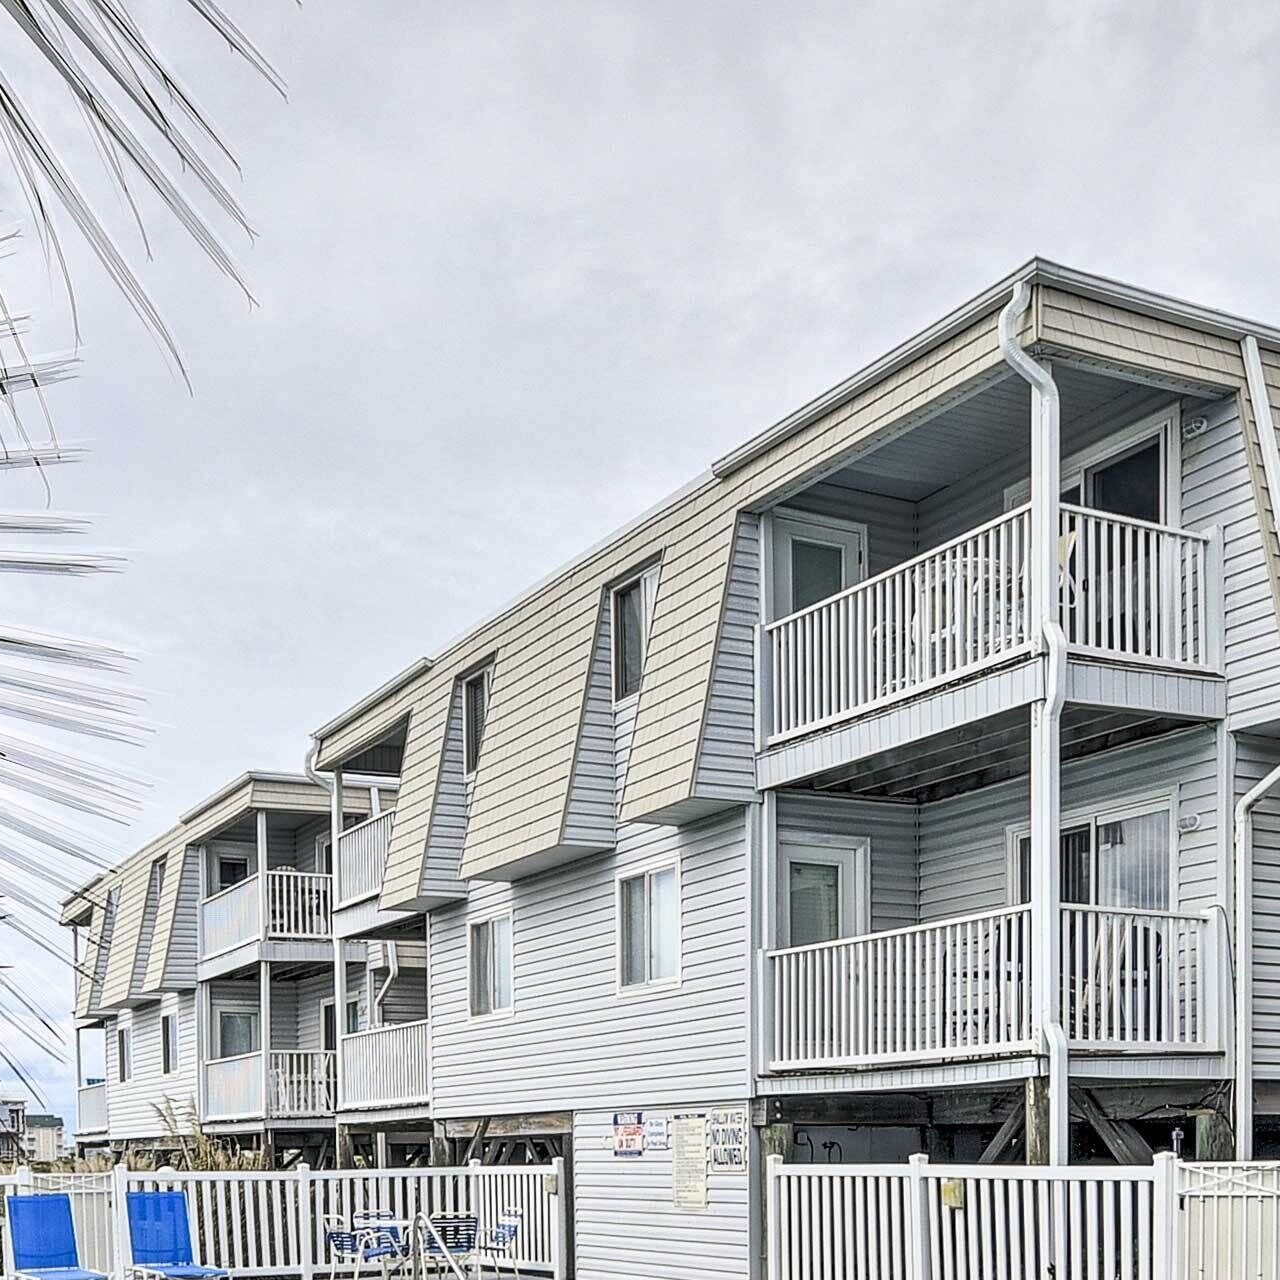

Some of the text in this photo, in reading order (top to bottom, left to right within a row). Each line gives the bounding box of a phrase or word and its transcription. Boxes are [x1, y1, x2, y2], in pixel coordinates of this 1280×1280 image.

[712, 1128, 742, 1145] NO DIVING
[713, 1148, 742, 1165] ALLOWED
